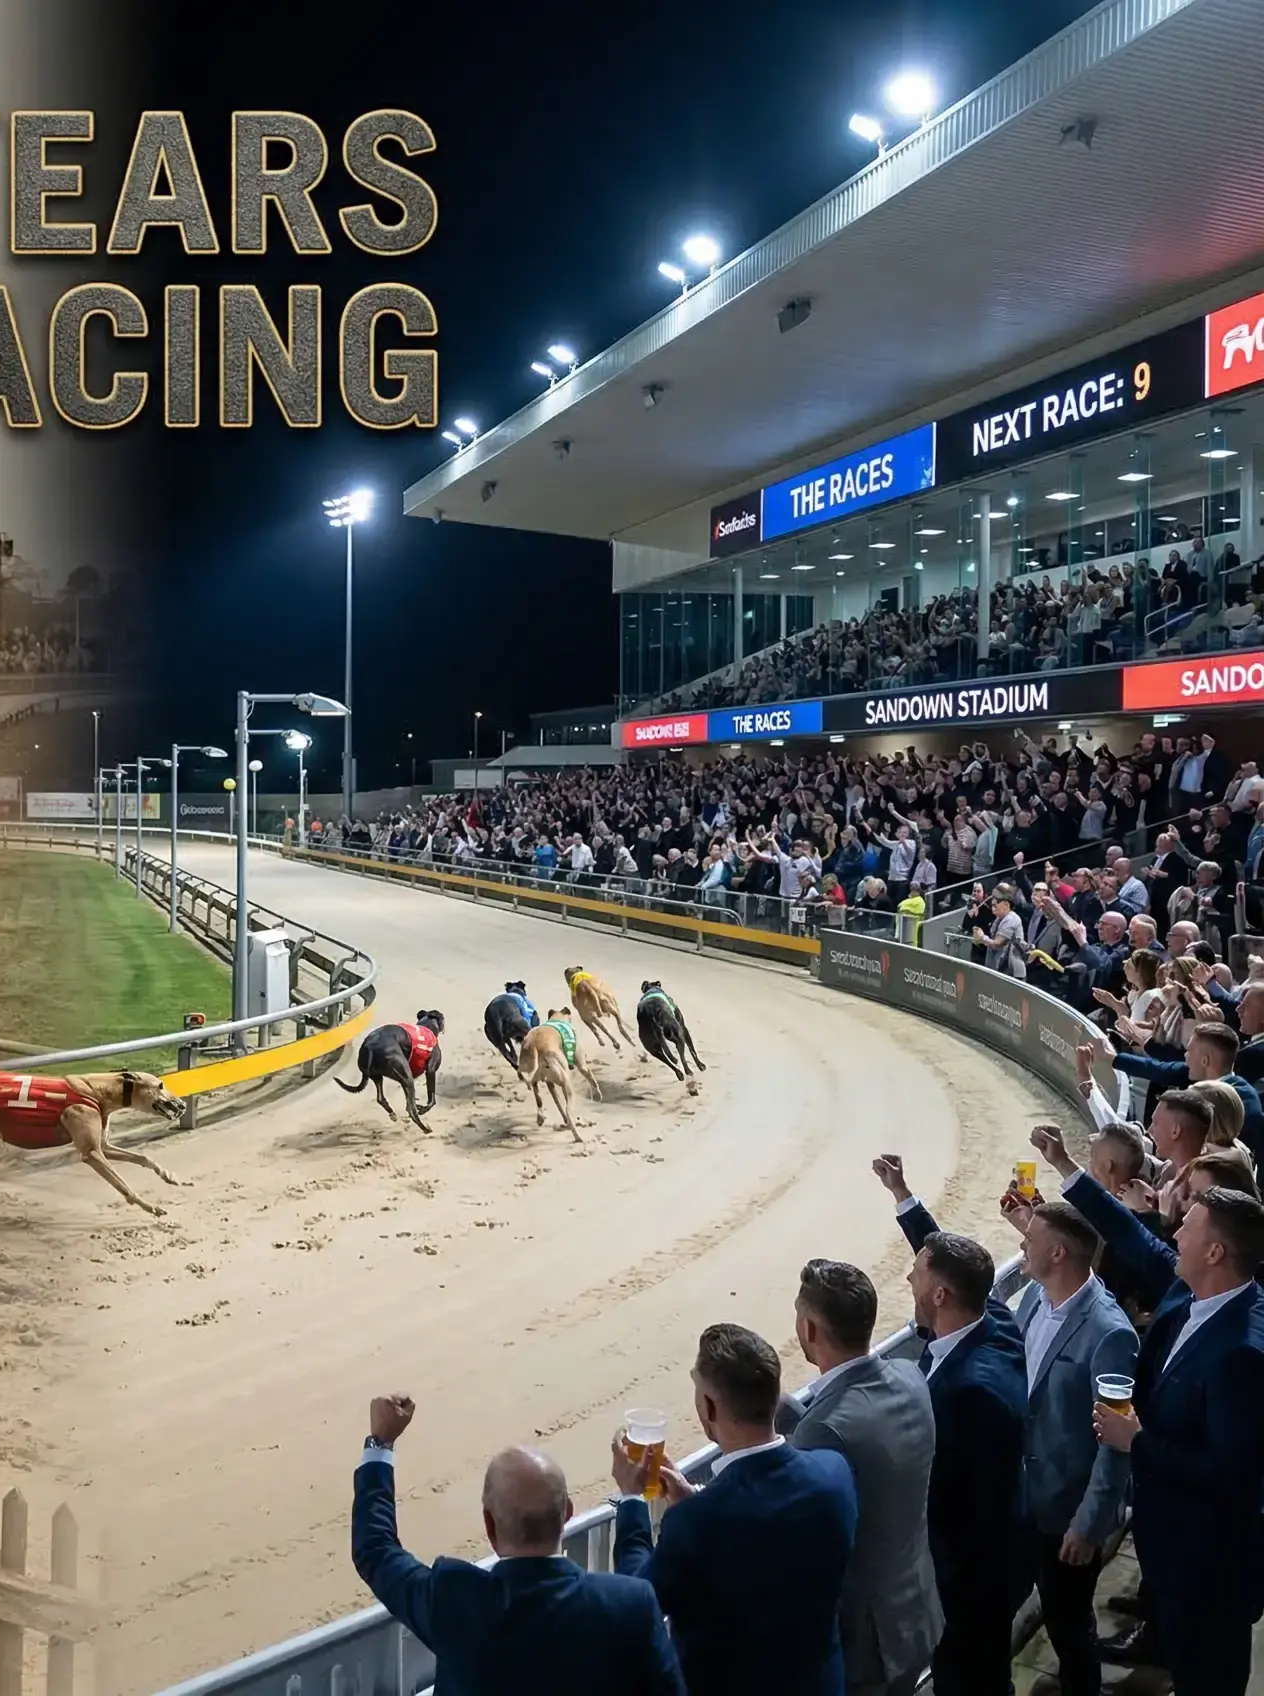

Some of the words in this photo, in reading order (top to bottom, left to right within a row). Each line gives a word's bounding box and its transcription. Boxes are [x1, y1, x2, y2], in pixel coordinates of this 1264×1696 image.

[972, 402, 1036, 456] NEXT
[1043, 372, 1124, 431] RACE:
[1133, 362, 1151, 401] 9
[790, 478, 825, 518] THE
[829, 454, 893, 506] RACES
[1181, 663, 1264, 697] SANDO
[733, 715, 754, 733] THE
[755, 710, 791, 732] RACES
[865, 692, 953, 725] SANDOWN
[957, 683, 1048, 716] STADIUM
[7, 1075, 37, 1108] 1
